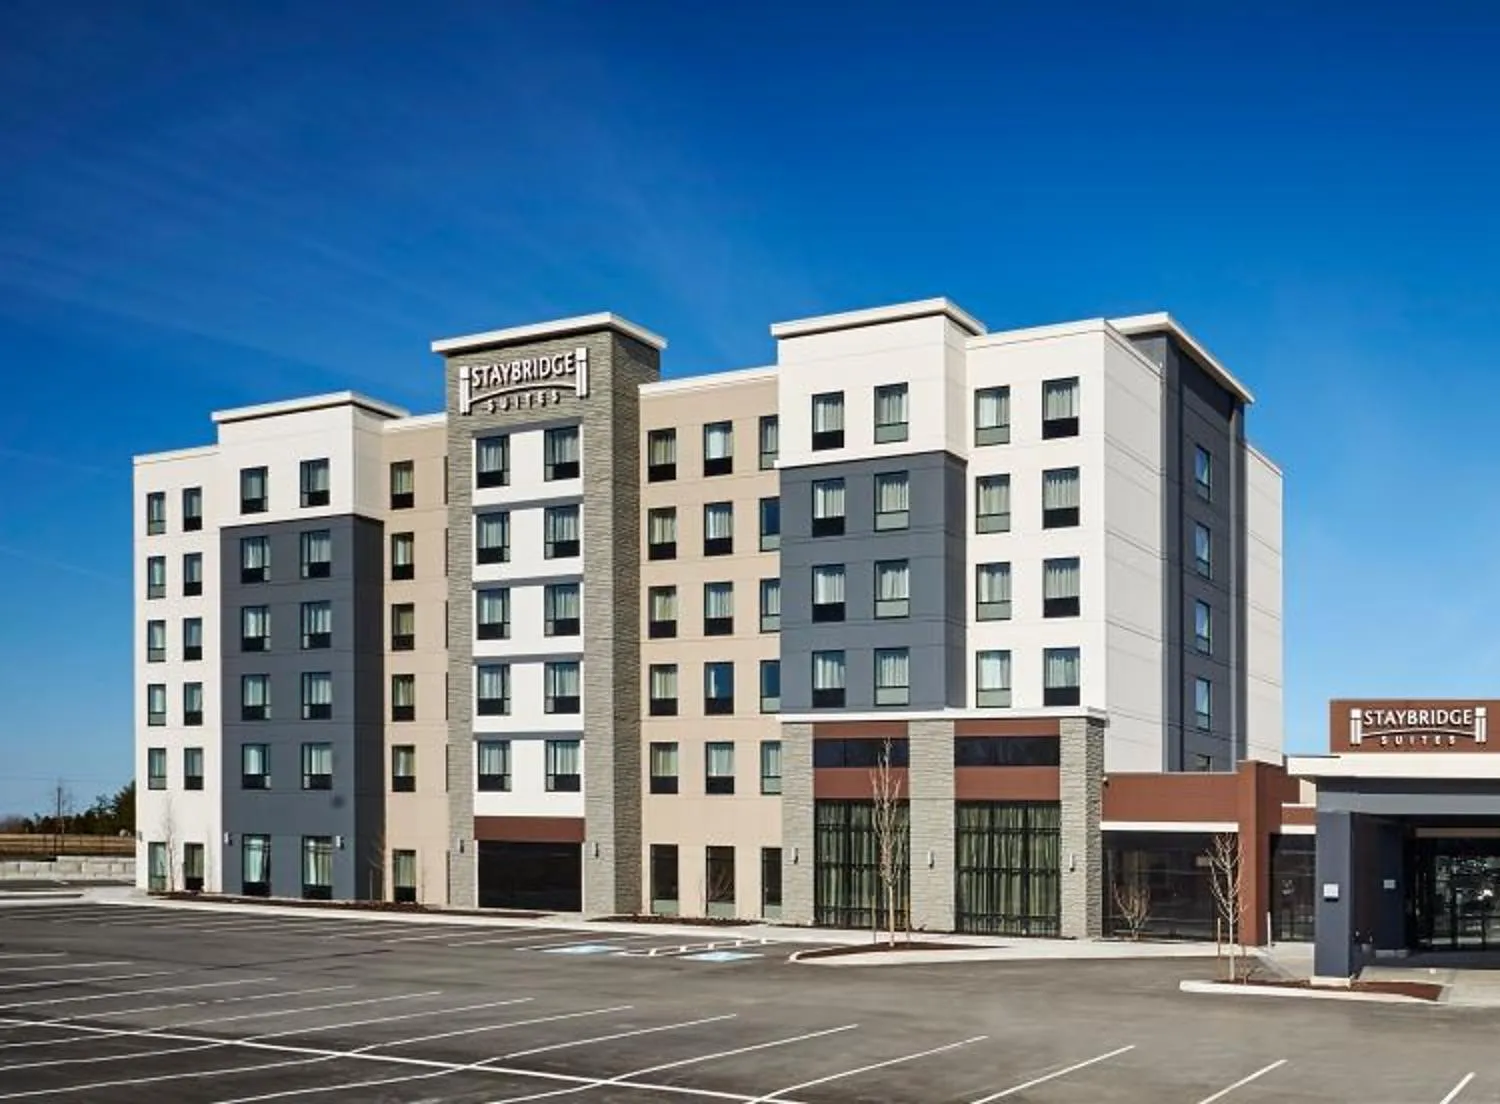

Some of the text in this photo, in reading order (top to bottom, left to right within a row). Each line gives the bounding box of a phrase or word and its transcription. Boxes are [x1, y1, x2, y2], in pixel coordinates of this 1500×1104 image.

[471, 351, 577, 388] STAYBRIDGE
[487, 390, 561, 414] SUITES
[1363, 709, 1473, 726] STAYBRIDGE
[1380, 735, 1456, 746] SUITES
